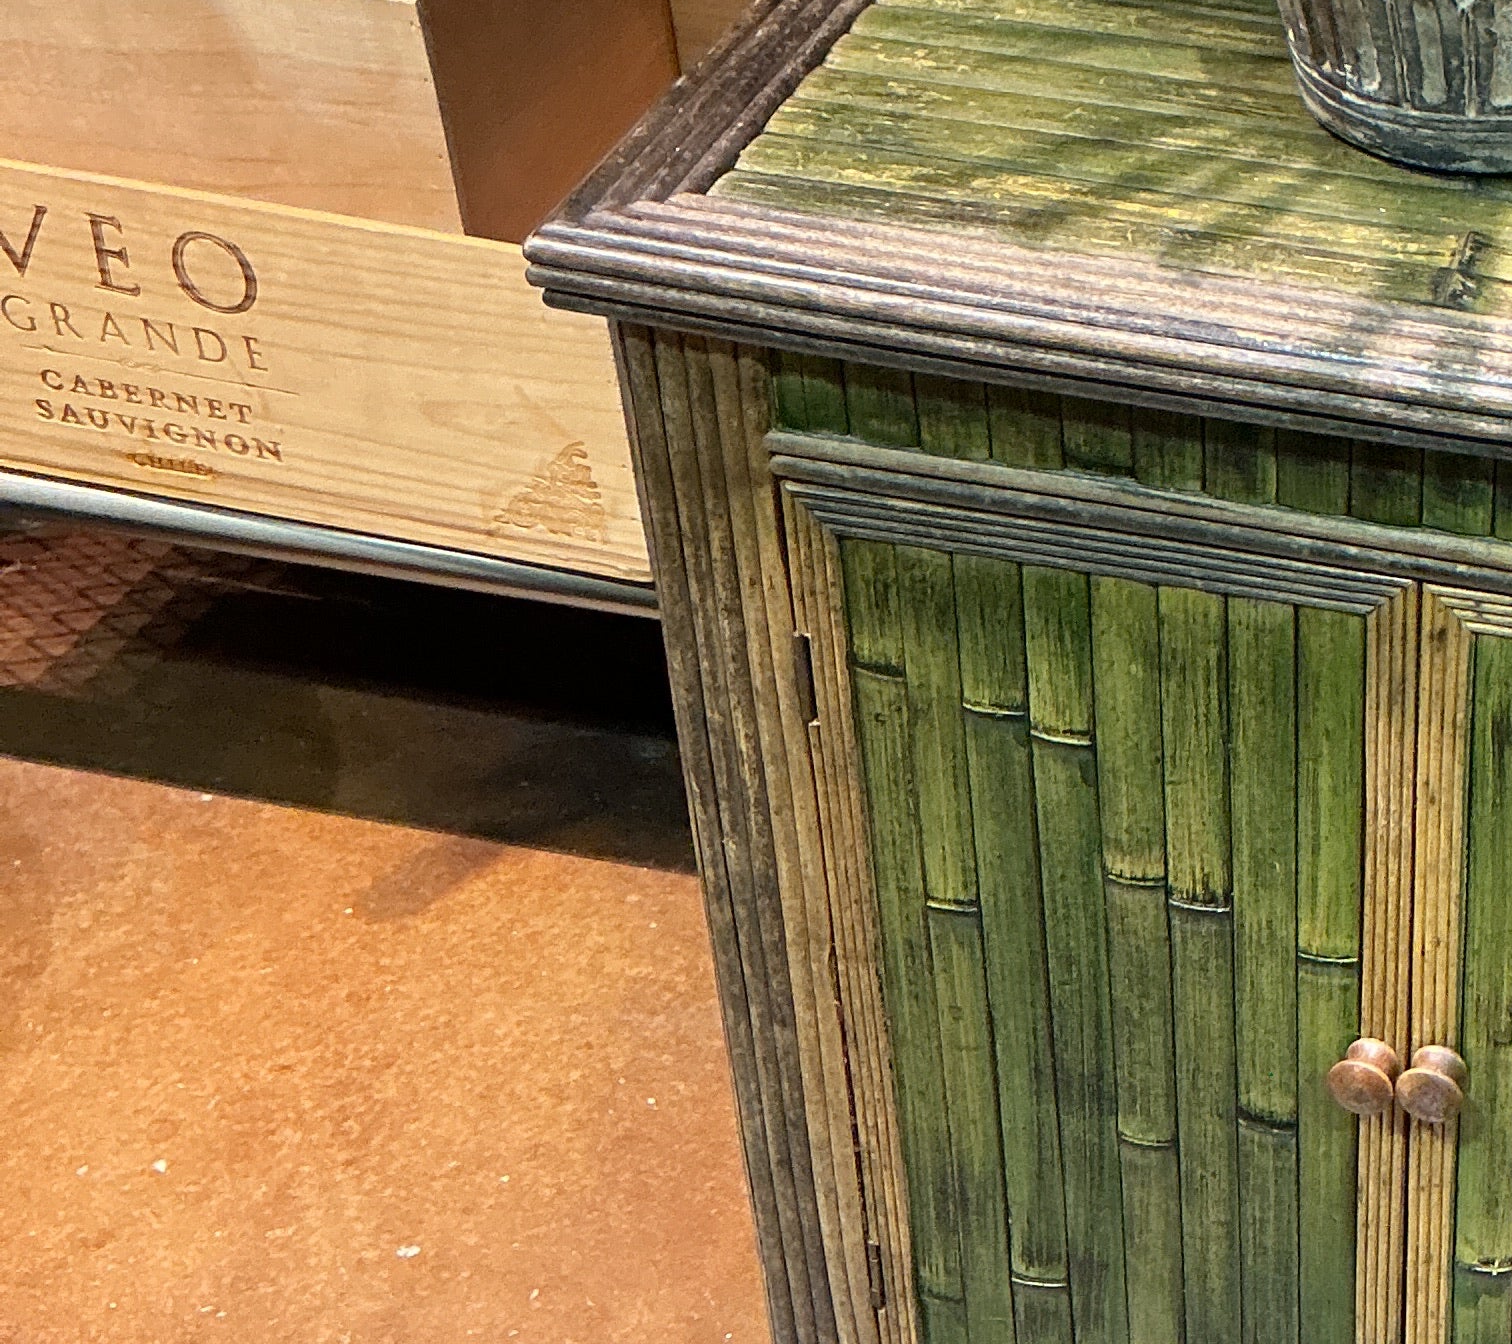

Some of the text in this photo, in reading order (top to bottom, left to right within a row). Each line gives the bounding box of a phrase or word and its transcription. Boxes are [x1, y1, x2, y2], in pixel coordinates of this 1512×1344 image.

[0, 205, 258, 315] VEO
[1, 294, 270, 372] GRANDE
[35, 398, 284, 463] SAUVIGNON
[41, 369, 253, 426] CABERNET
